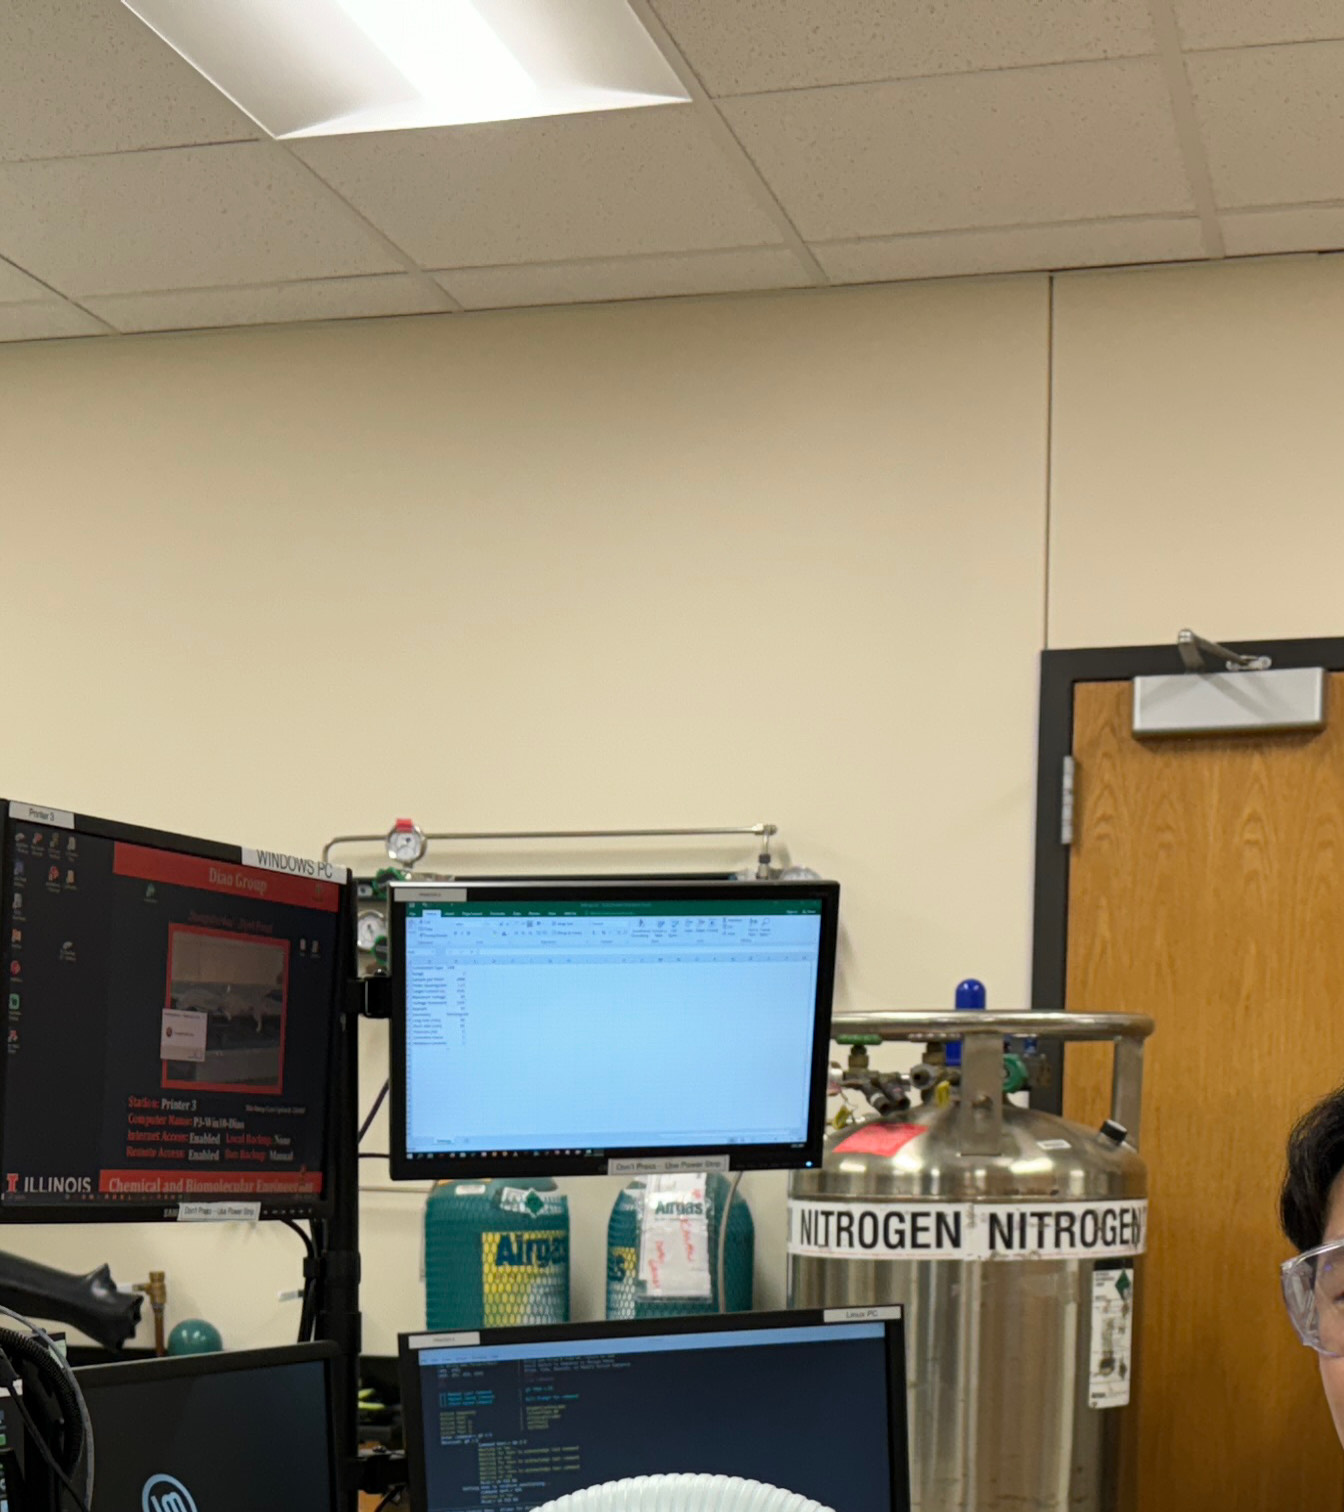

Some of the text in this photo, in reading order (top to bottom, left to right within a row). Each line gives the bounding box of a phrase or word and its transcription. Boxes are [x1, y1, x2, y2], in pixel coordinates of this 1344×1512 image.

[29, 808, 55, 821] Printer 3
[256, 849, 333, 878] WINDOWS PC
[209, 867, 268, 896] Diao Group
[161, 1098, 190, 1110] Printer
[191, 1099, 197, 1111] 3
[189, 1133, 221, 1145] Enabled
[188, 1149, 220, 1161] Enabled
[24, 1177, 92, 1193] ILLINOIS
[109, 1176, 160, 1193] Chemical
[163, 1178, 183, 1193] and
[186, 1178, 254, 1193] Biomolecular
[655, 1201, 703, 1216] Airgas
[801, 1206, 1140, 1250] NITROGEN NITROGEN
[845, 1309, 879, 1318] Linux PC
